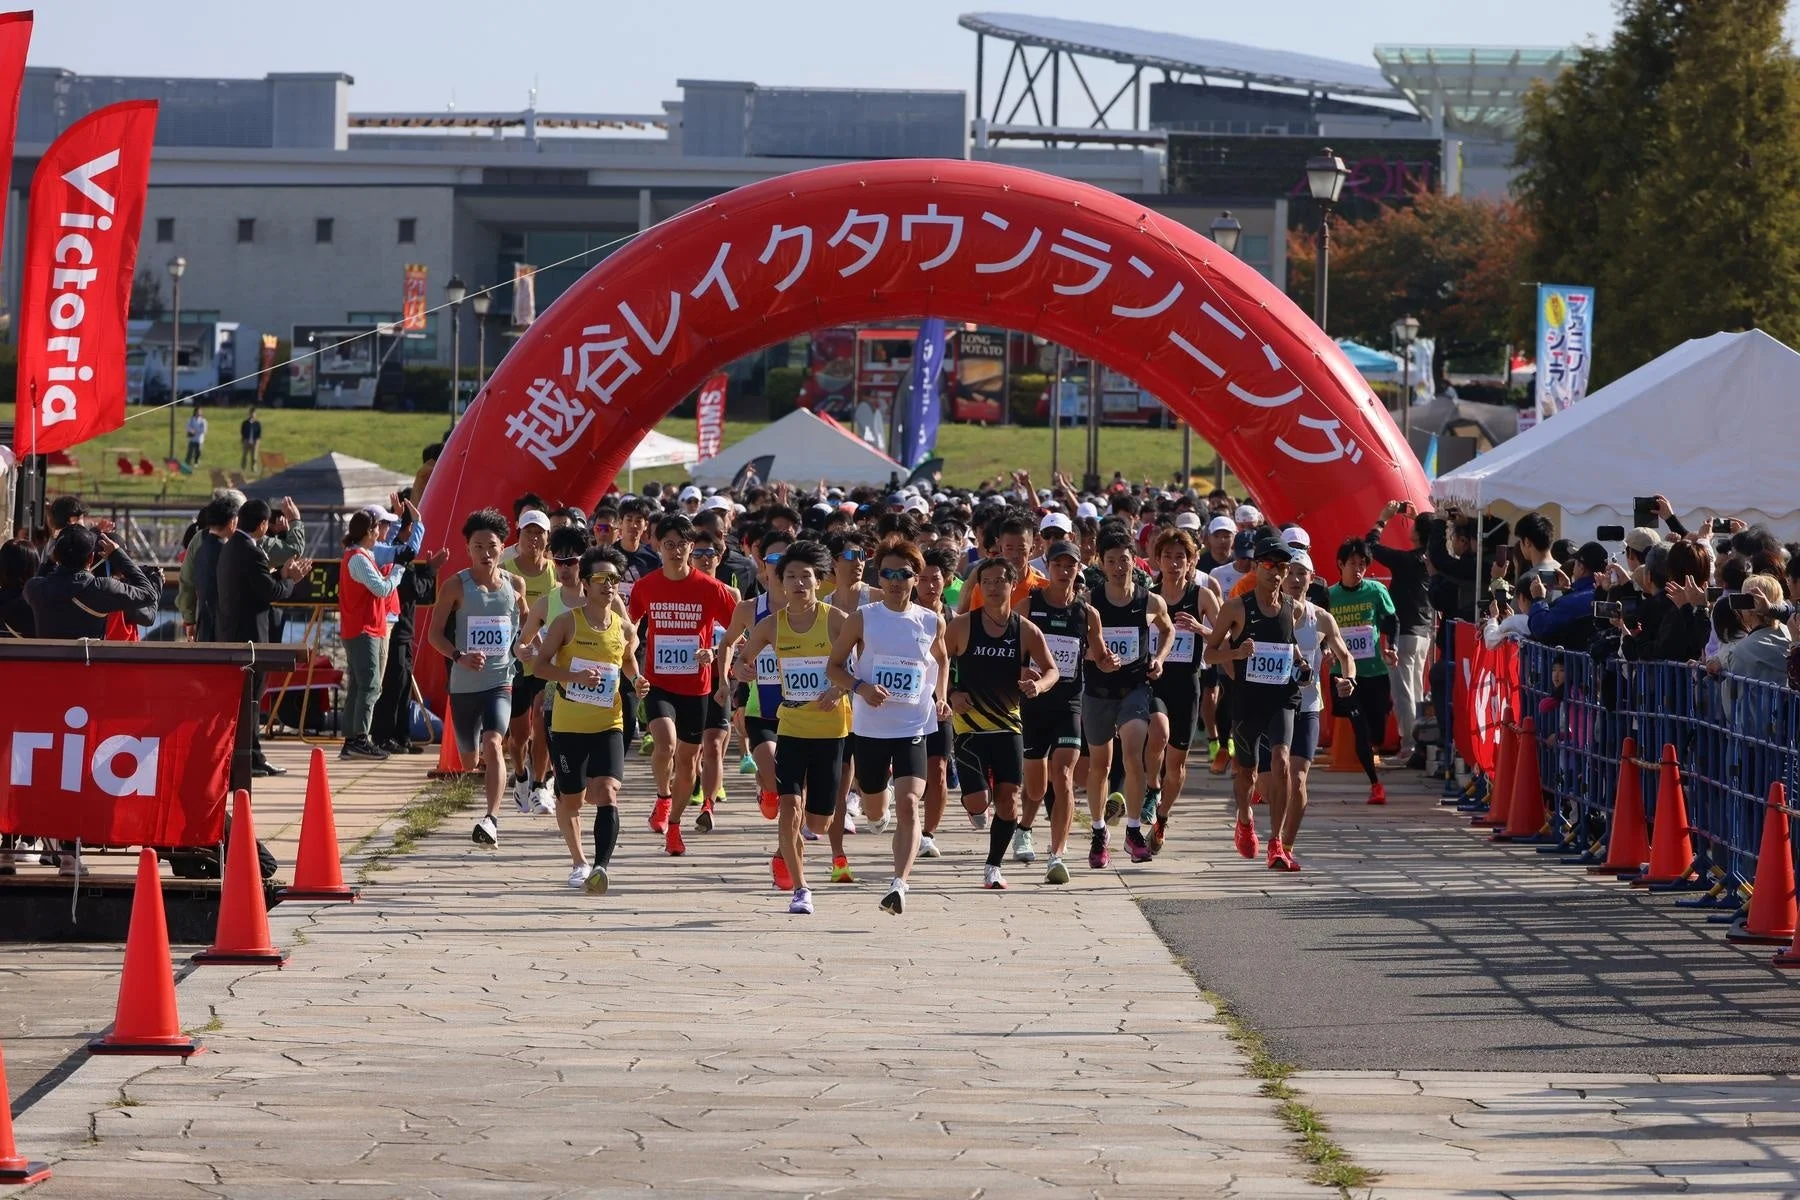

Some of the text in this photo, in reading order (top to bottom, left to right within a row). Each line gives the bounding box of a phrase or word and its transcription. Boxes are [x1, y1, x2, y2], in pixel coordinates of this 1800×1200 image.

[42, 148, 120, 427] Victoria
[505, 203, 1363, 471] 越谷レイクタウンランニング
[960, 333, 991, 344] LONG
[960, 343, 1003, 356] POTATO
[649, 602, 703, 612] KOSHIGAYA
[651, 611, 702, 621] LAKE TOWN
[1334, 612, 1361, 623] ONIC
[655, 620, 697, 629] RUNNING
[470, 630, 503, 645] 1203
[658, 648, 688, 664] 1210
[973, 646, 1015, 657] MORE
[1251, 656, 1284, 674] 1304
[784, 672, 819, 690] 1200
[875, 671, 912, 692] 1052
[10, 706, 160, 796] ria
